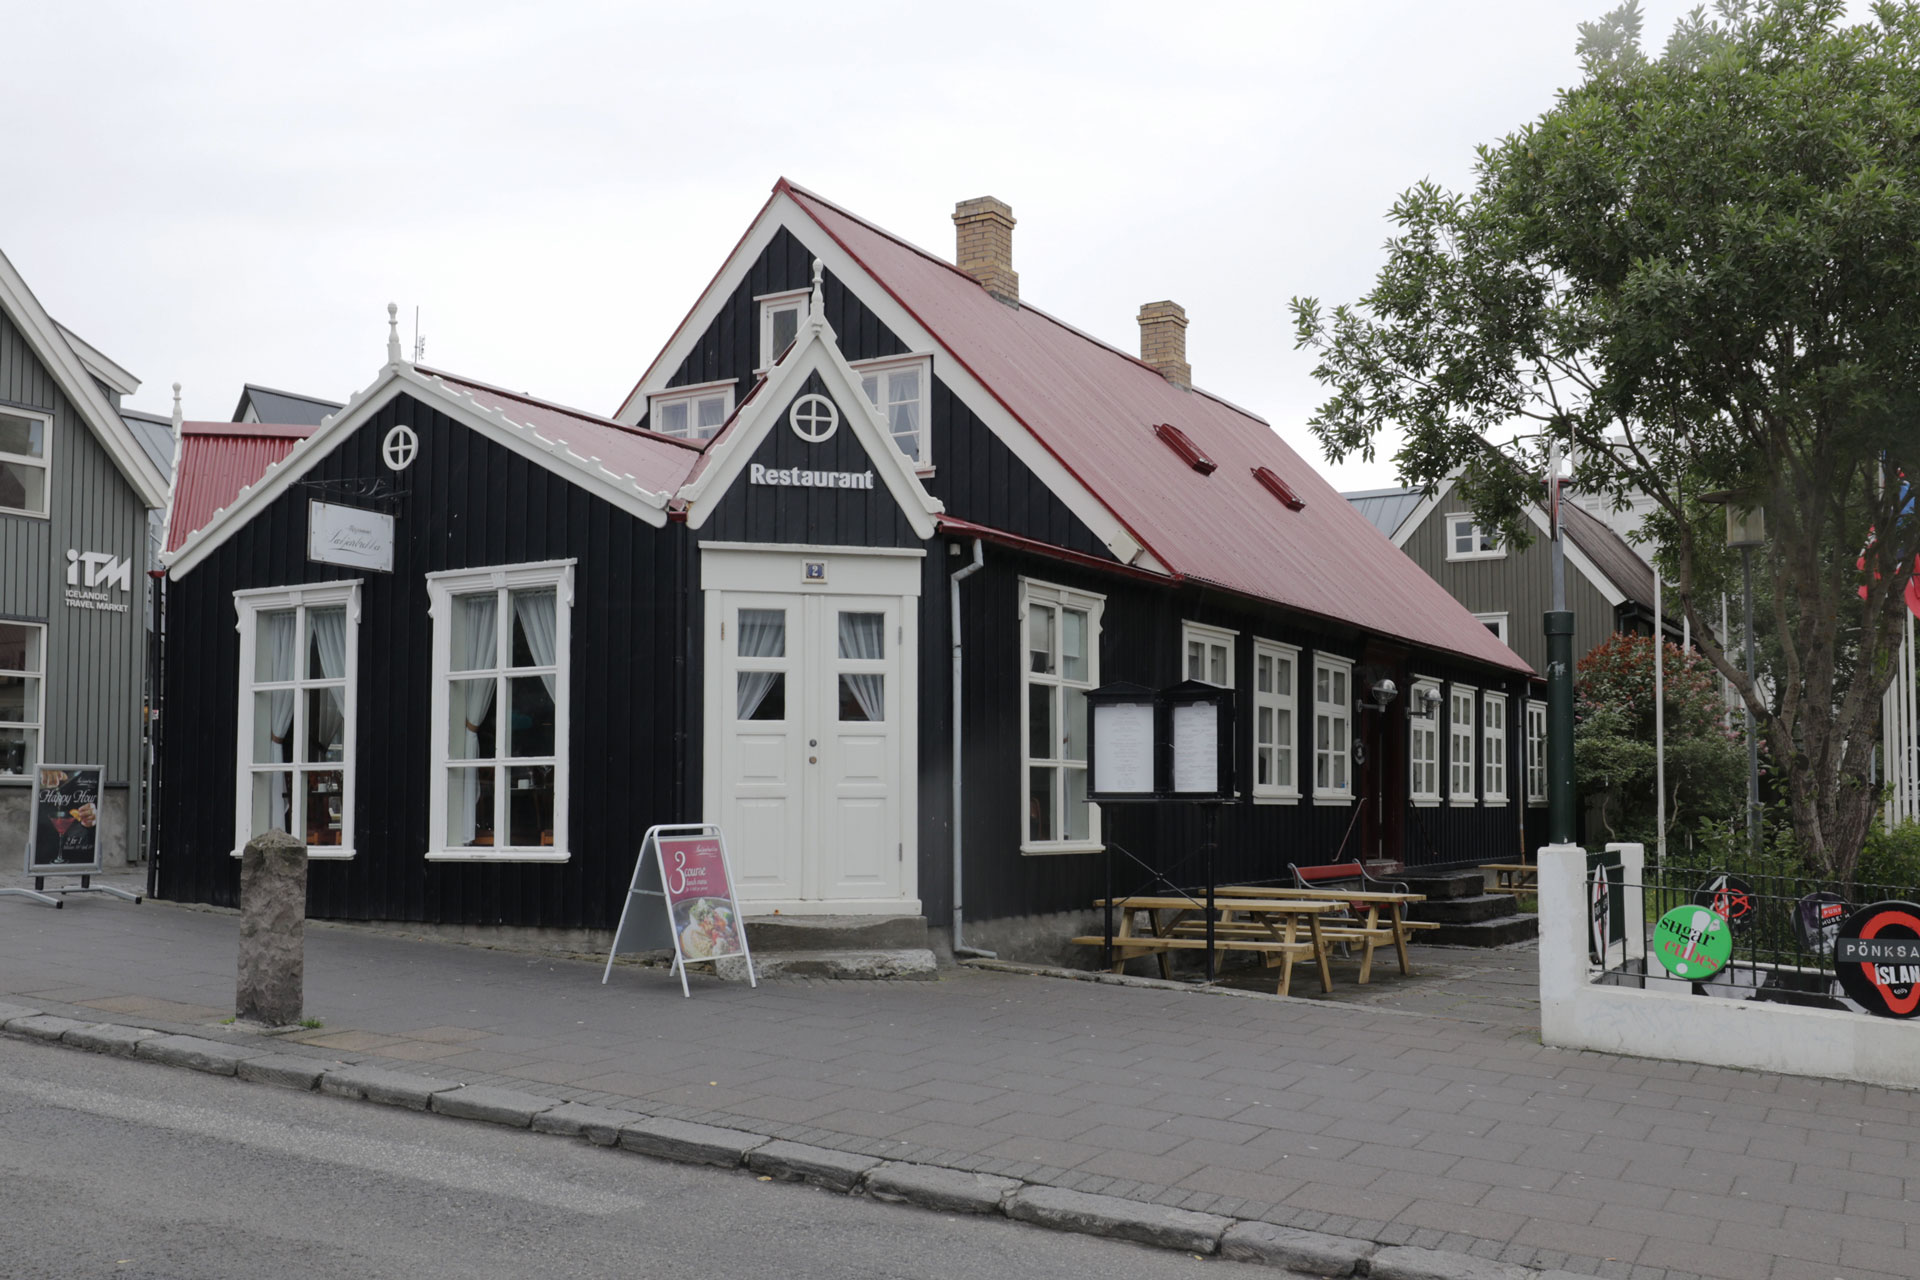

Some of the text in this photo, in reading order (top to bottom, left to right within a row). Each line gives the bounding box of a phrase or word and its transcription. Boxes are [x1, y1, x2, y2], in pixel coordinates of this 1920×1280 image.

[750, 463, 874, 489] Restaurant
[812, 565, 819, 577] 2
[65, 589, 109, 601] ICELANDIC
[65, 598, 128, 612] TRAVEL MARKET
[40, 789, 97, 806] Happy Hour
[669, 851, 706, 894] 3 course
[1659, 917, 1715, 947] sugar
[1664, 940, 1720, 971] cubes
